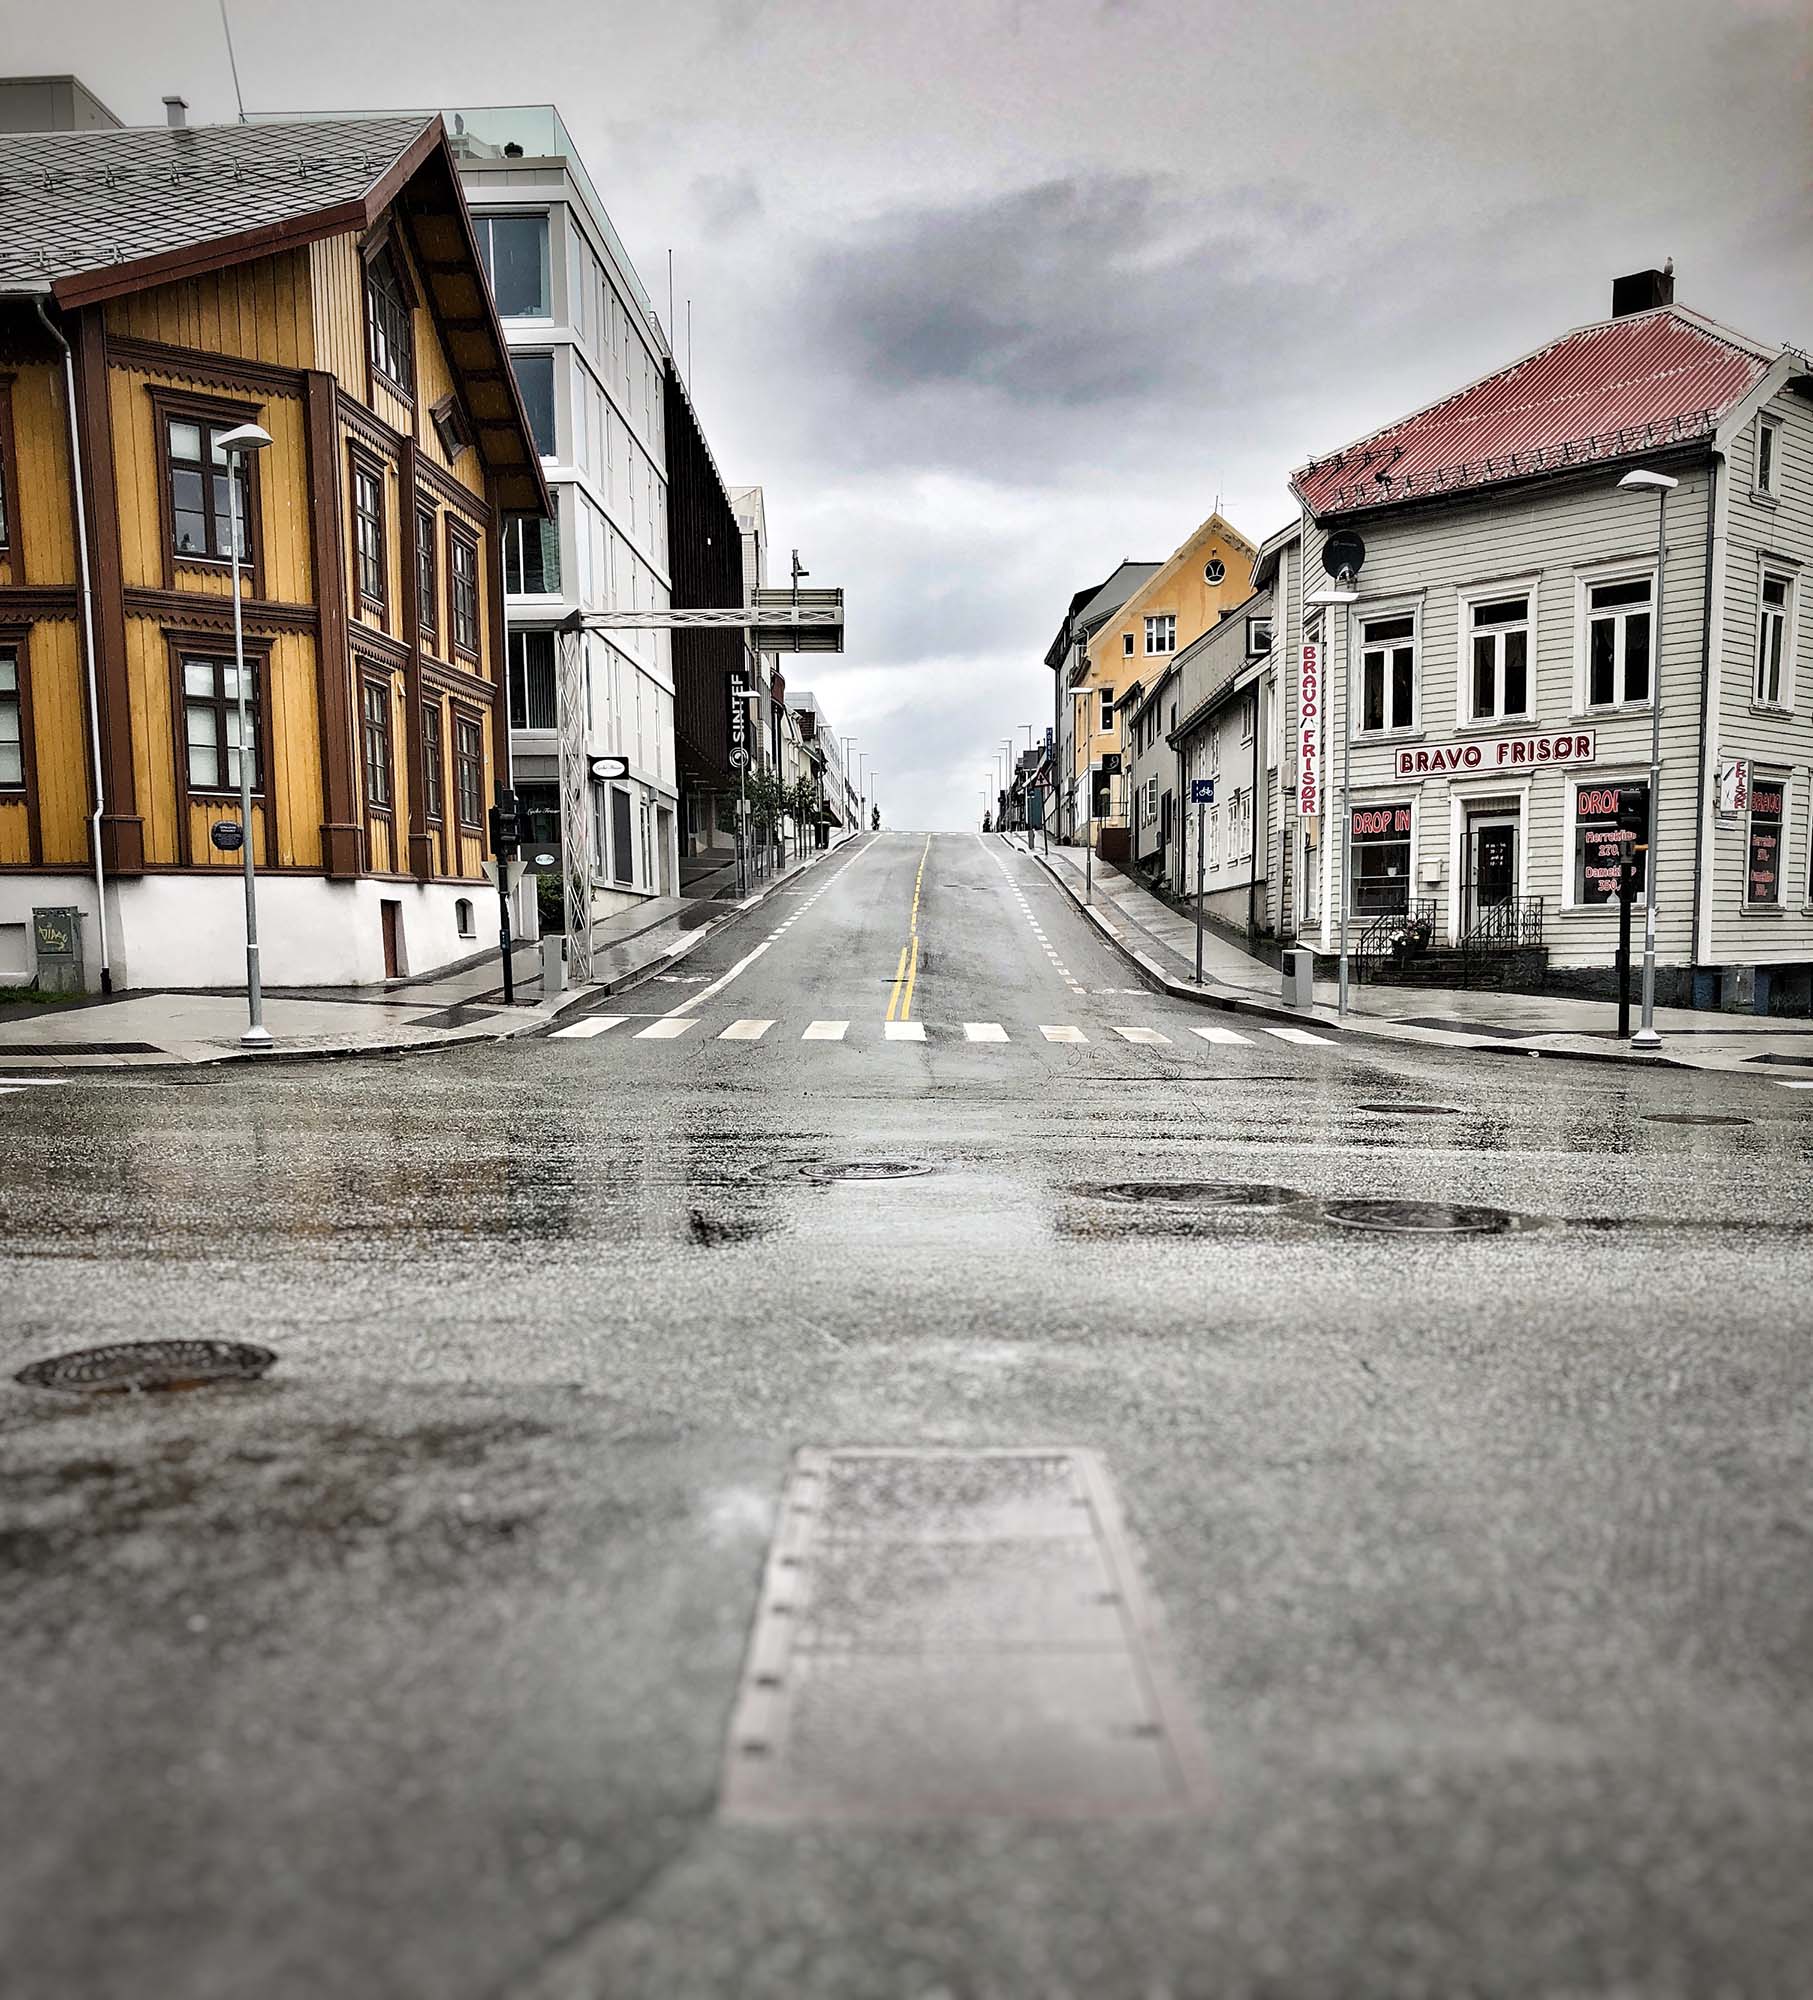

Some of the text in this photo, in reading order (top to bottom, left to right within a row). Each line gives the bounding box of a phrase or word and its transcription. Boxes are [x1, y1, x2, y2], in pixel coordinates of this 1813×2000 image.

[731, 674, 745, 742] SINTEF
[1301, 646, 1317, 813] BRAVO FRISØR
[1400, 736, 1590, 773] BRAVO FRISØR
[1734, 762, 1747, 809] FRISØR
[1353, 810, 1410, 834] DROP IN
